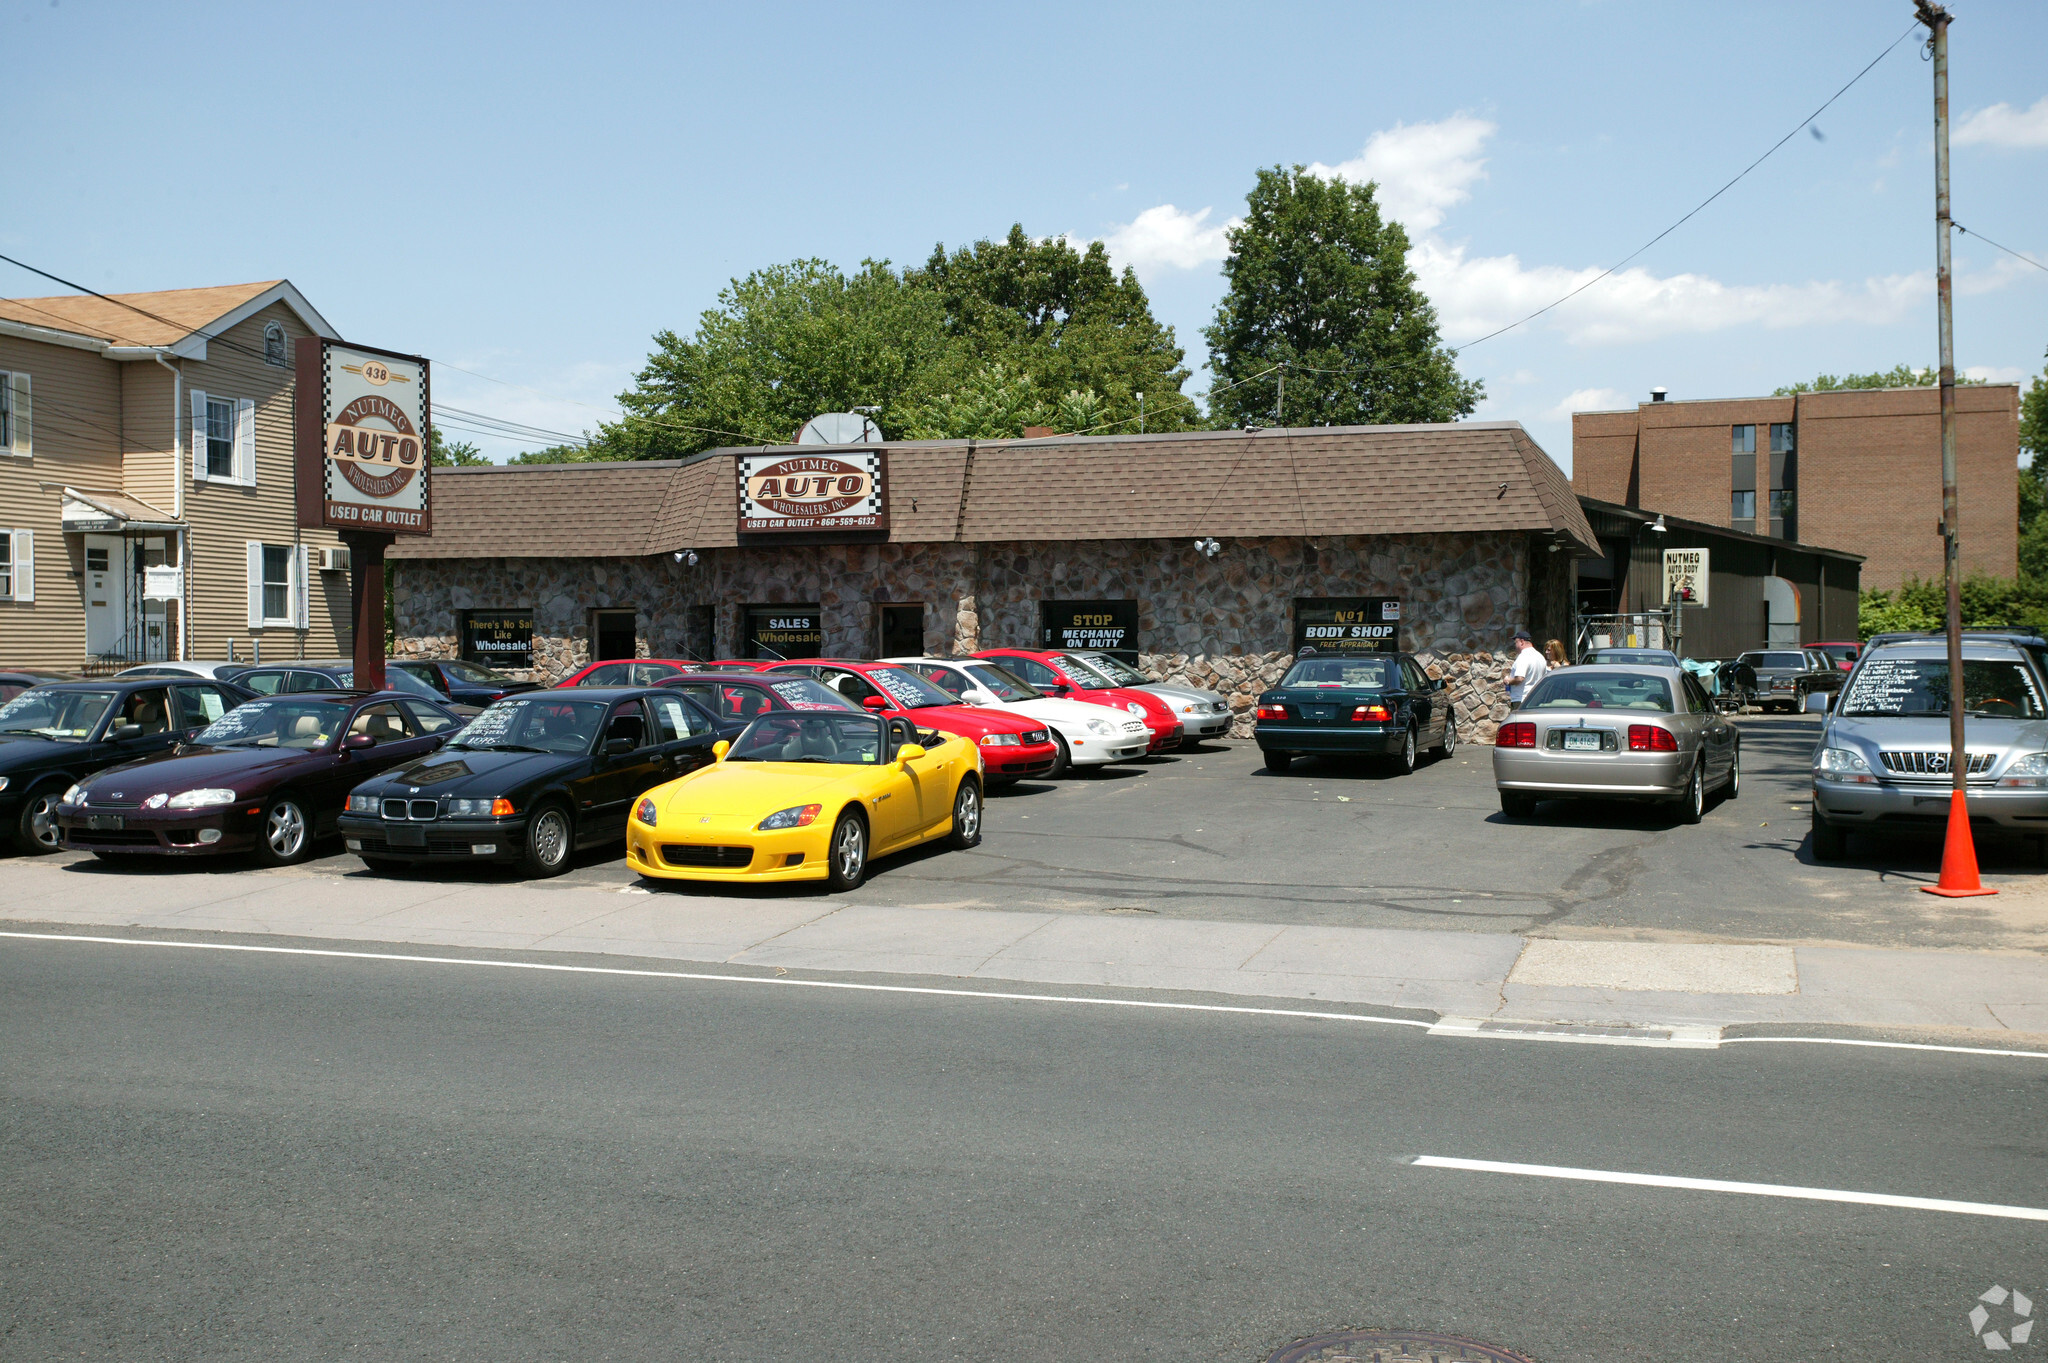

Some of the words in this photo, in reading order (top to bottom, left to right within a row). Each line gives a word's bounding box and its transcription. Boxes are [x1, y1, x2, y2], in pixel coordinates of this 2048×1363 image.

[366, 366, 387, 380] 438
[346, 399, 407, 430] NUTMEG
[334, 429, 419, 465] AUTO
[778, 459, 839, 474] NUTMEG
[757, 475, 864, 498] AUTO
[773, 500, 831, 515] WHOLESALERS,
[831, 498, 849, 511] INC.
[330, 504, 359, 520] USED
[361, 508, 383, 522] CAR
[385, 510, 423, 526] OUTLET
[747, 520, 767, 528] USED
[769, 519, 784, 527] CAR
[787, 518, 815, 527] OUTLET
[821, 516, 876, 526] 860-569-6132
[1666, 552, 1699, 564] NUTMEG
[1668, 565, 1682, 573] AUTO
[1684, 565, 1698, 573] BODY
[468, 619, 500, 629] There's
[503, 619, 515, 629] No
[518, 619, 533, 629] Sal
[769, 618, 810, 629] SALES
[1073, 614, 1113, 626] STOP
[494, 630, 512, 639] Like
[758, 632, 821, 642] Wholesale
[1062, 629, 1125, 639] MECHANIC
[1305, 626, 1346, 638] BODY
[1351, 626, 1393, 637] SHOP
[475, 640, 532, 651] Wholesale!
[1066, 638, 1083, 648] ON
[1088, 638, 1120, 648] DUTY
[1339, 640, 1380, 648] APPRAISALS
